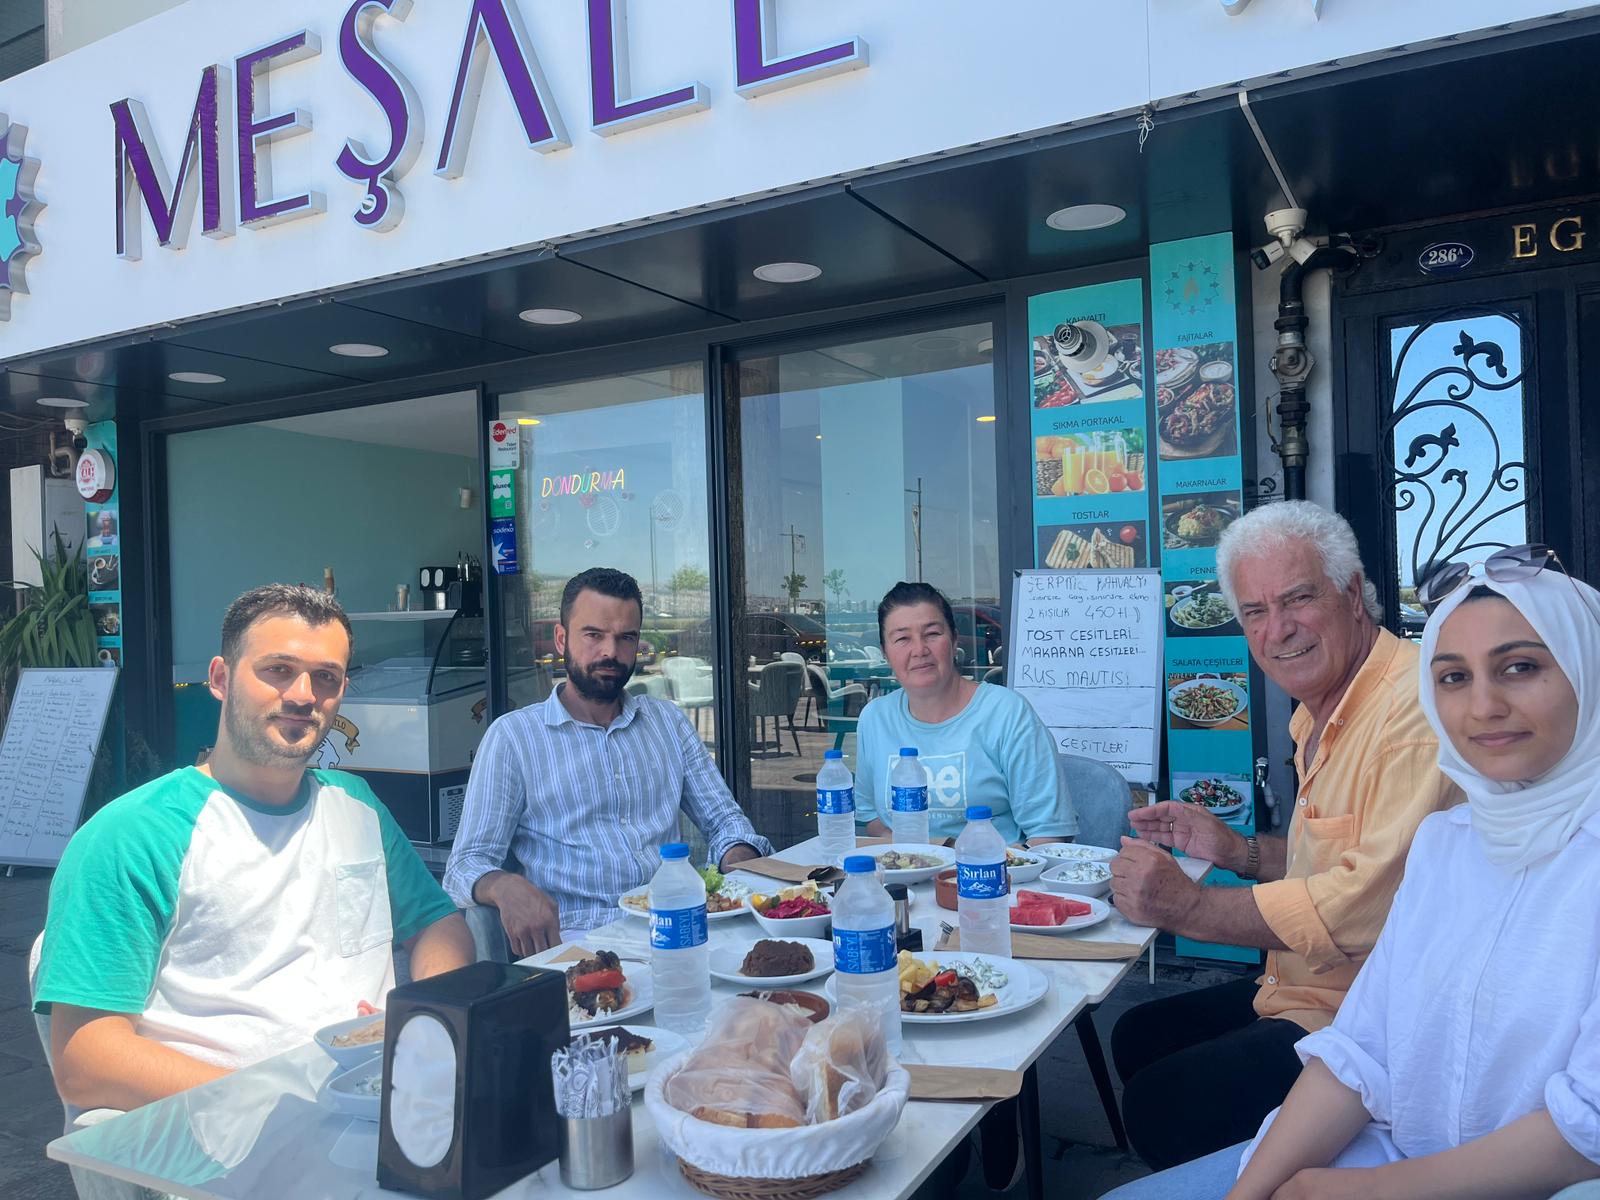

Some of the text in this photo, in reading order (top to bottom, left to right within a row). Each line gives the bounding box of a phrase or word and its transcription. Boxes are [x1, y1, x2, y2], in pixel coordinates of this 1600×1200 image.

[1081, 415, 1125, 428] PORTAKAL
[541, 467, 625, 498] DONDURMA
[1175, 477, 1227, 489] MAKARNALAR
[1071, 510, 1110, 520] TOSTLAR
[1190, 567, 1217, 575] PENNE
[1026, 629, 1065, 641] TOST
[1021, 646, 1085, 658] MAKARNA
[1172, 659, 1202, 667] SALATA
[1022, 664, 1056, 686] RUS
